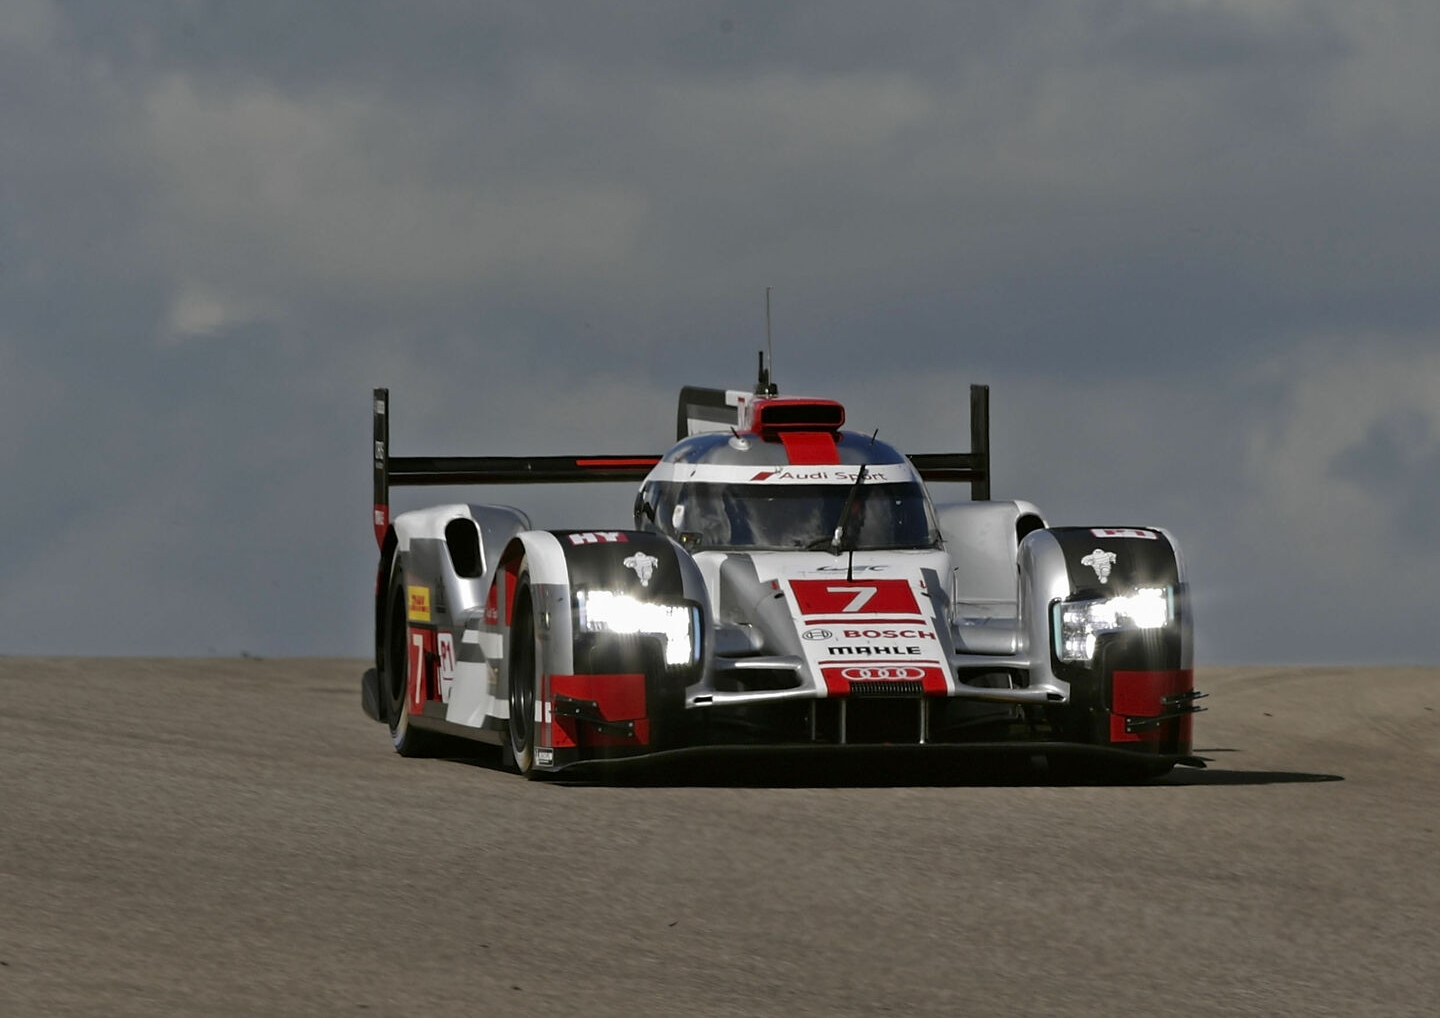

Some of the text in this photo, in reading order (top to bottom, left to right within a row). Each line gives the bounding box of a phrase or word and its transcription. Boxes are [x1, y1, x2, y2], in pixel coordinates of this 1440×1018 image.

[780, 472, 888, 482] Audi Sport
[825, 586, 878, 613] 7
[843, 630, 937, 640] BOSCH
[827, 646, 922, 656] MAHLE
[412, 633, 424, 704] 7
